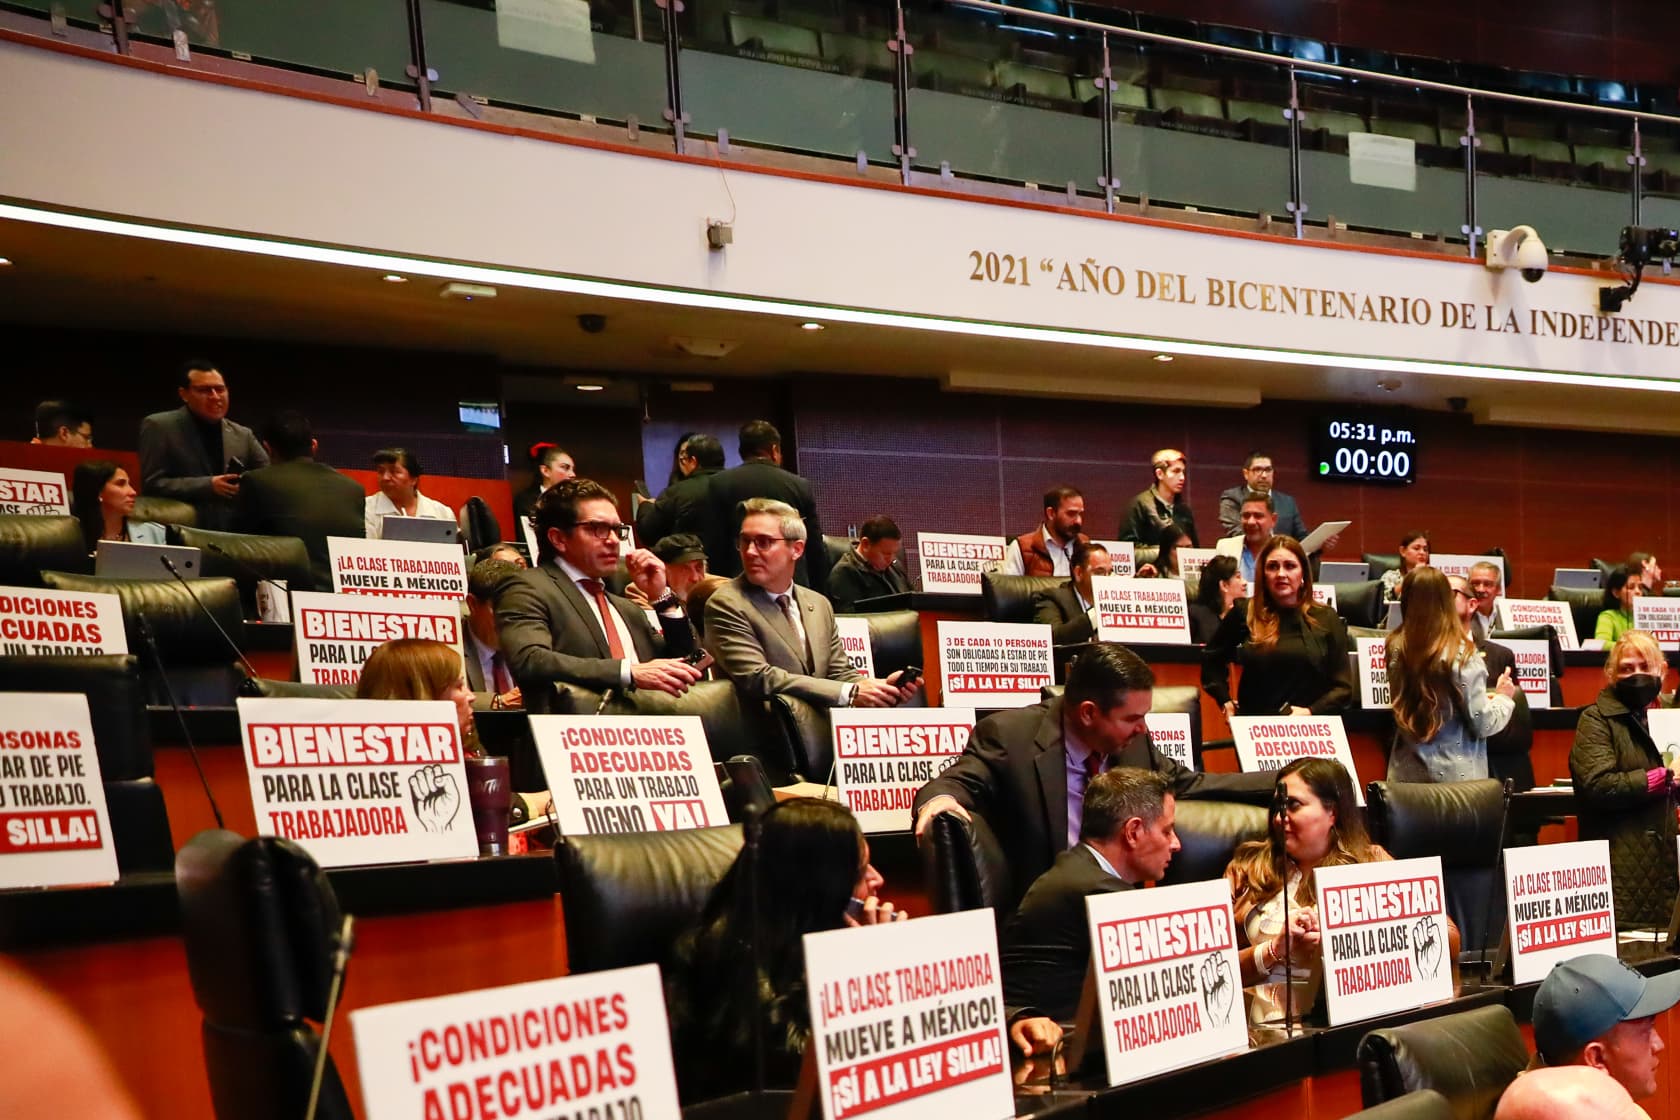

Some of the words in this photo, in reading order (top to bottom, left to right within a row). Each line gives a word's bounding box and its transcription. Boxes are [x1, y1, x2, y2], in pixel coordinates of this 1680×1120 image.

[969, 249, 1030, 286] 2021
[1040, 257, 1126, 297] “AÑO
[1136, 270, 1197, 304] DEL
[1207, 278, 1431, 326] BICENTENARIO
[1441, 302, 1477, 330] DE
[1485, 306, 1520, 334] LA
[1329, 421, 1377, 442] 05:31
[1381, 424, 1416, 445] p.m.
[1335, 448, 1410, 477] 00:00
[356, 556, 388, 572] CLASE
[390, 558, 460, 575] TRABAJADORA
[923, 543, 1002, 559] BIENESTAR
[925, 559, 945, 570] PARA
[946, 560, 956, 570] LA
[957, 560, 980, 571] CLASE
[340, 573, 388, 589] MUEVE
[393, 576, 403, 588] A
[406, 575, 462, 591] MÉXICO!
[927, 571, 981, 584] TRABAJADORA
[305, 611, 453, 642] BIENESTAR
[310, 644, 347, 663] PARA
[350, 647, 366, 664] LA
[946, 637, 952, 646] 3
[953, 637, 965, 646] DE
[967, 637, 990, 647] CADA
[993, 638, 1003, 647] 10
[1005, 638, 1048, 648] PERSONAS
[946, 648, 961, 659] SON
[962, 649, 999, 660] OBLIGADAS
[1000, 649, 1006, 660] A
[1006, 650, 1027, 660] ESTAR
[1027, 650, 1036, 660] DE
[1037, 650, 1048, 661] PIE
[947, 661, 965, 672] TODO
[965, 662, 974, 672] EL
[974, 662, 999, 672] TIEMPO
[999, 662, 1009, 672] EN
[1009, 662, 1019, 673] SU
[1019, 662, 1048, 673] TRABAJO.
[967, 677, 976, 689] A
[978, 677, 993, 689] LA
[995, 677, 1015, 689] LEY
[254, 726, 453, 764] BIENESTAR
[561, 727, 685, 749] ¡CONDICIONES
[1255, 740, 1336, 756] ADECUADAS
[32, 755, 53, 778] DE
[56, 755, 85, 777] PIE
[570, 750, 692, 773] ADECUADAS
[843, 763, 877, 784] PARA
[879, 762, 895, 782] LA
[897, 762, 934, 782] CLASE
[8, 784, 90, 806] TRABAJO.
[263, 773, 315, 802] PARA
[318, 773, 343, 800] LA
[346, 771, 401, 799] CLASE
[574, 777, 615, 800] PARA
[615, 777, 638, 799] UN
[637, 775, 699, 798] TRABAJO
[8, 816, 97, 845] SILLA!
[269, 807, 407, 840] TRABAJADORA
[1512, 875, 1525, 901] ¡LA
[1526, 872, 1551, 895] CLASE
[1551, 865, 1607, 890] TRABAJADORA
[1327, 880, 1438, 925] BIENESTAR
[1514, 899, 1551, 922] MUEVE
[1554, 897, 1562, 916] A
[1564, 891, 1609, 914] MÉXICO!
[1102, 910, 1228, 967] BIENESTAR
[1331, 931, 1360, 961] PARA
[1361, 929, 1376, 956] LA
[1377, 924, 1409, 954] CLASE
[1518, 930, 1532, 951] ¡SÍ
[1534, 929, 1542, 945] A
[1543, 926, 1558, 943] LA
[1558, 922, 1577, 940] LEY
[1578, 916, 1611, 937] SILLA!
[820, 981, 844, 1026] ¡LA
[847, 971, 893, 1014] CLASE
[895, 953, 993, 1001] TRABAJADORA
[1109, 974, 1142, 1011] PARA
[1143, 971, 1160, 1003] LA
[1160, 963, 1197, 999] CLASE
[1334, 957, 1412, 996] TRABAJADORA
[409, 994, 628, 1082] ¡CONDICIONES
[825, 1020, 895, 1064] MUEVE
[902, 1015, 915, 1045] A
[920, 996, 997, 1040] MÉXICO!
[1114, 1002, 1201, 1052] TRABAJADORA
[832, 1074, 861, 1116] ¡SÍ
[863, 1070, 880, 1102] A
[880, 1062, 908, 1096] LA
[909, 1052, 942, 1088] LEY
[946, 1037, 1001, 1077] SILLA!
